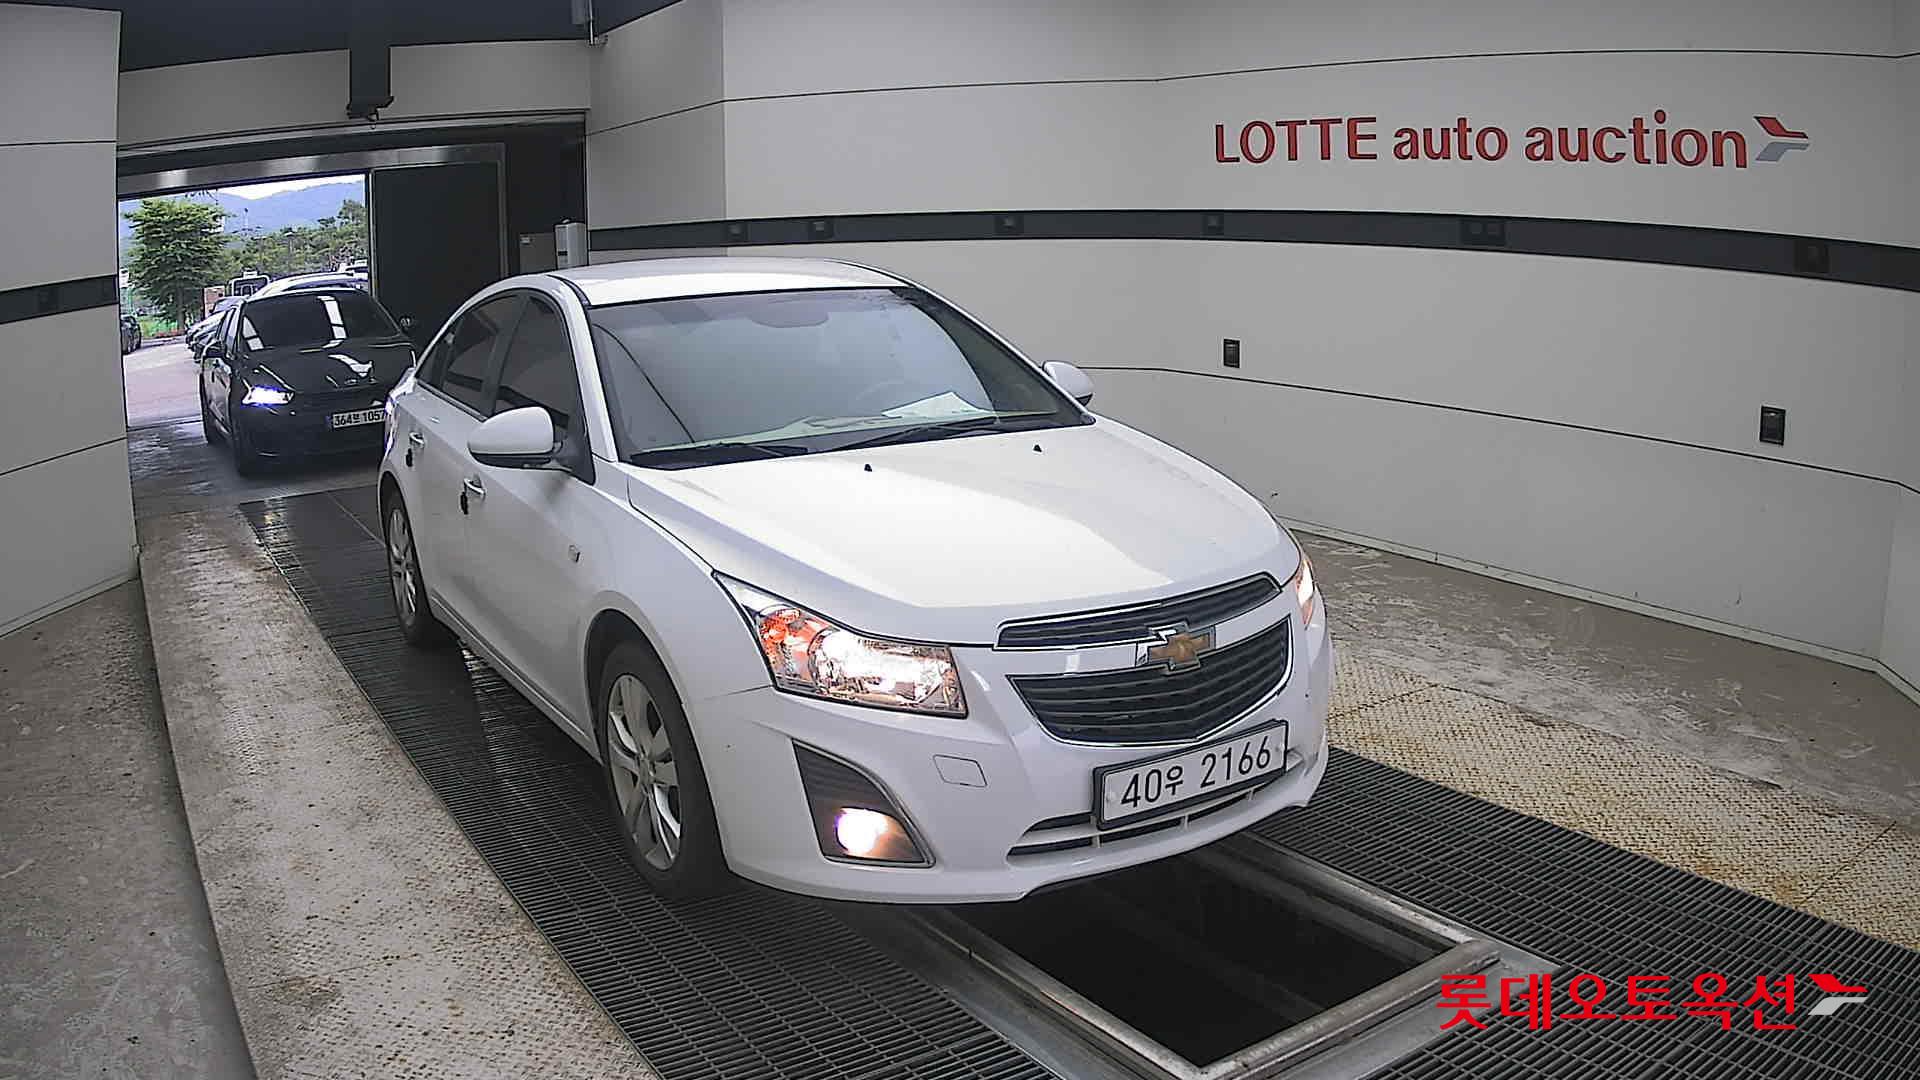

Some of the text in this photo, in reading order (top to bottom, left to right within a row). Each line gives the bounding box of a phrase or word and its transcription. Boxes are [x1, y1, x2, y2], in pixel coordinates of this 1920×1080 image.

[1215, 109, 1748, 168] LOTTE auto auction
[1120, 736, 1271, 808] 40우 2166
